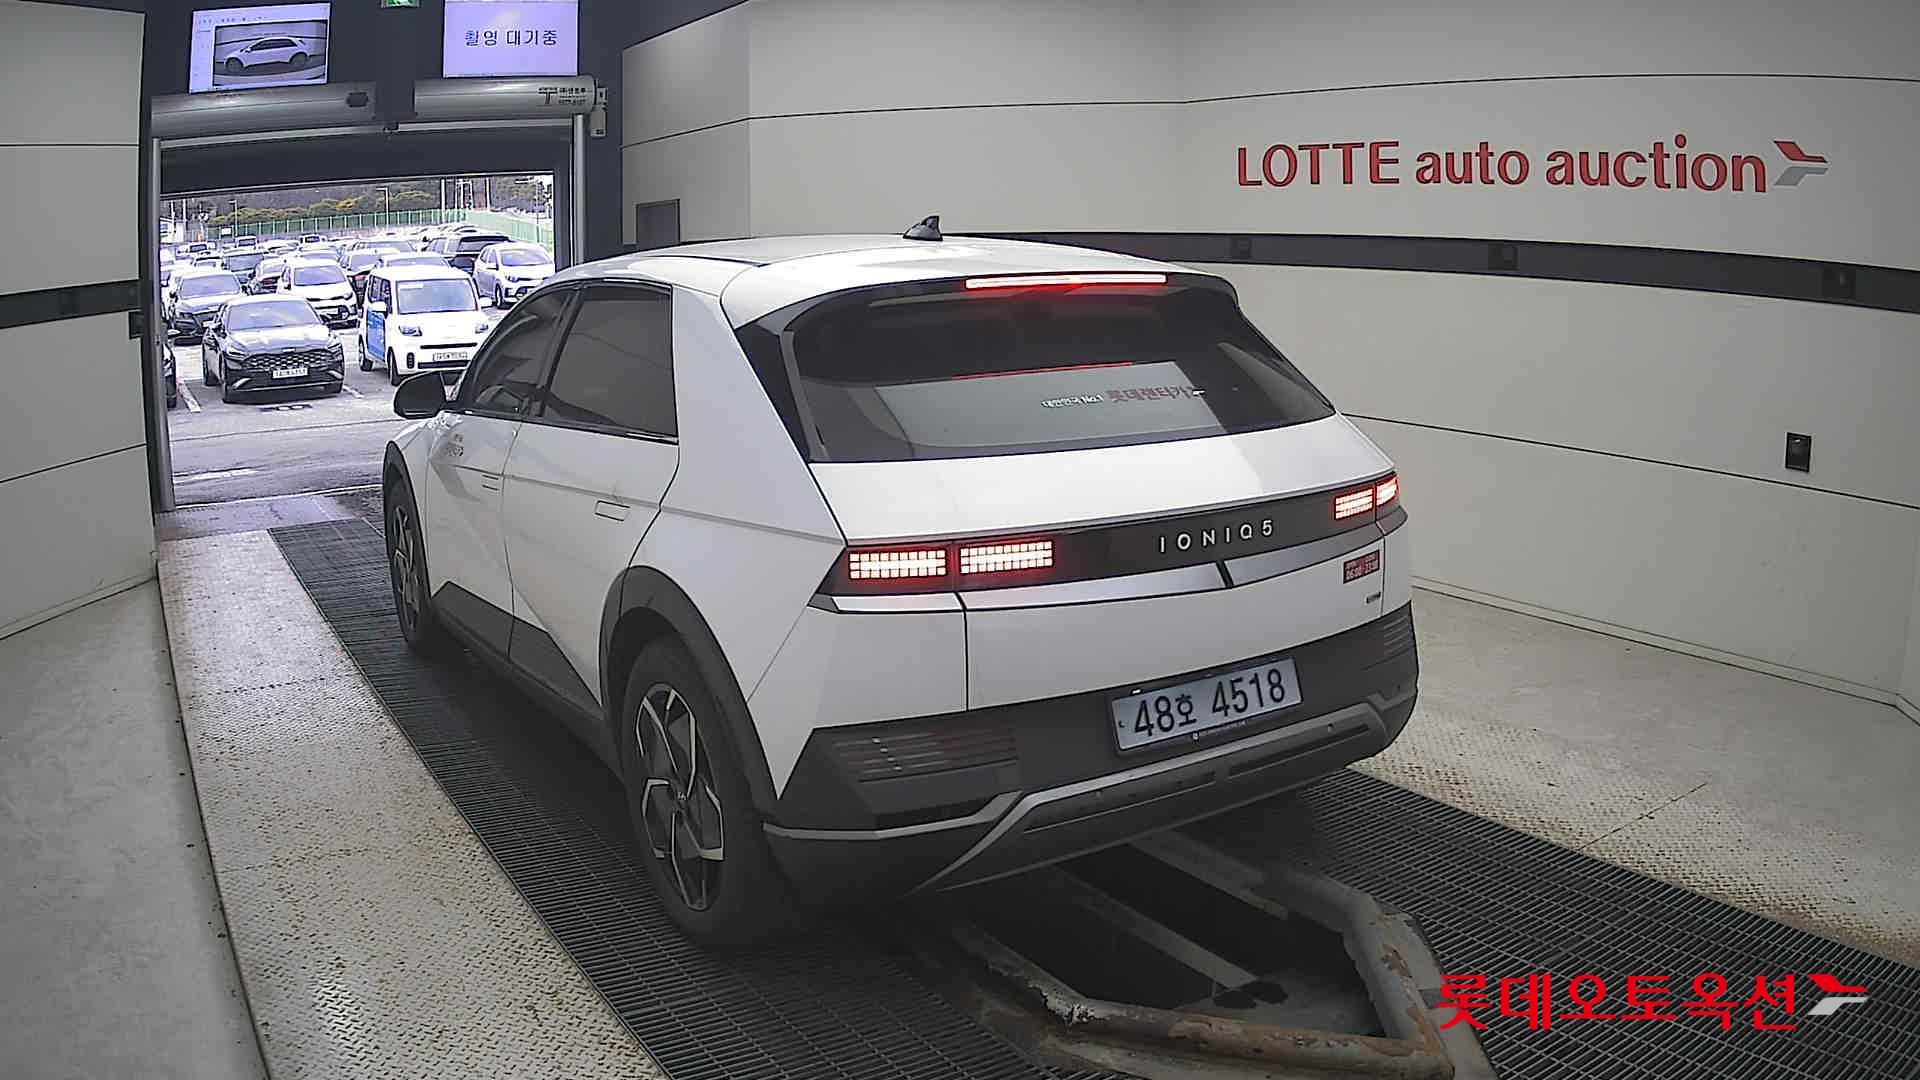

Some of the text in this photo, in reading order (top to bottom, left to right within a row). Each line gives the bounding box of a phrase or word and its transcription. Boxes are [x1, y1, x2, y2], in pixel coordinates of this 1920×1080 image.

[464, 30, 558, 46] 촬영 대기중
[1237, 134, 1767, 193] LOTTE auto auction
[1133, 667, 1286, 737] 48호 4518
